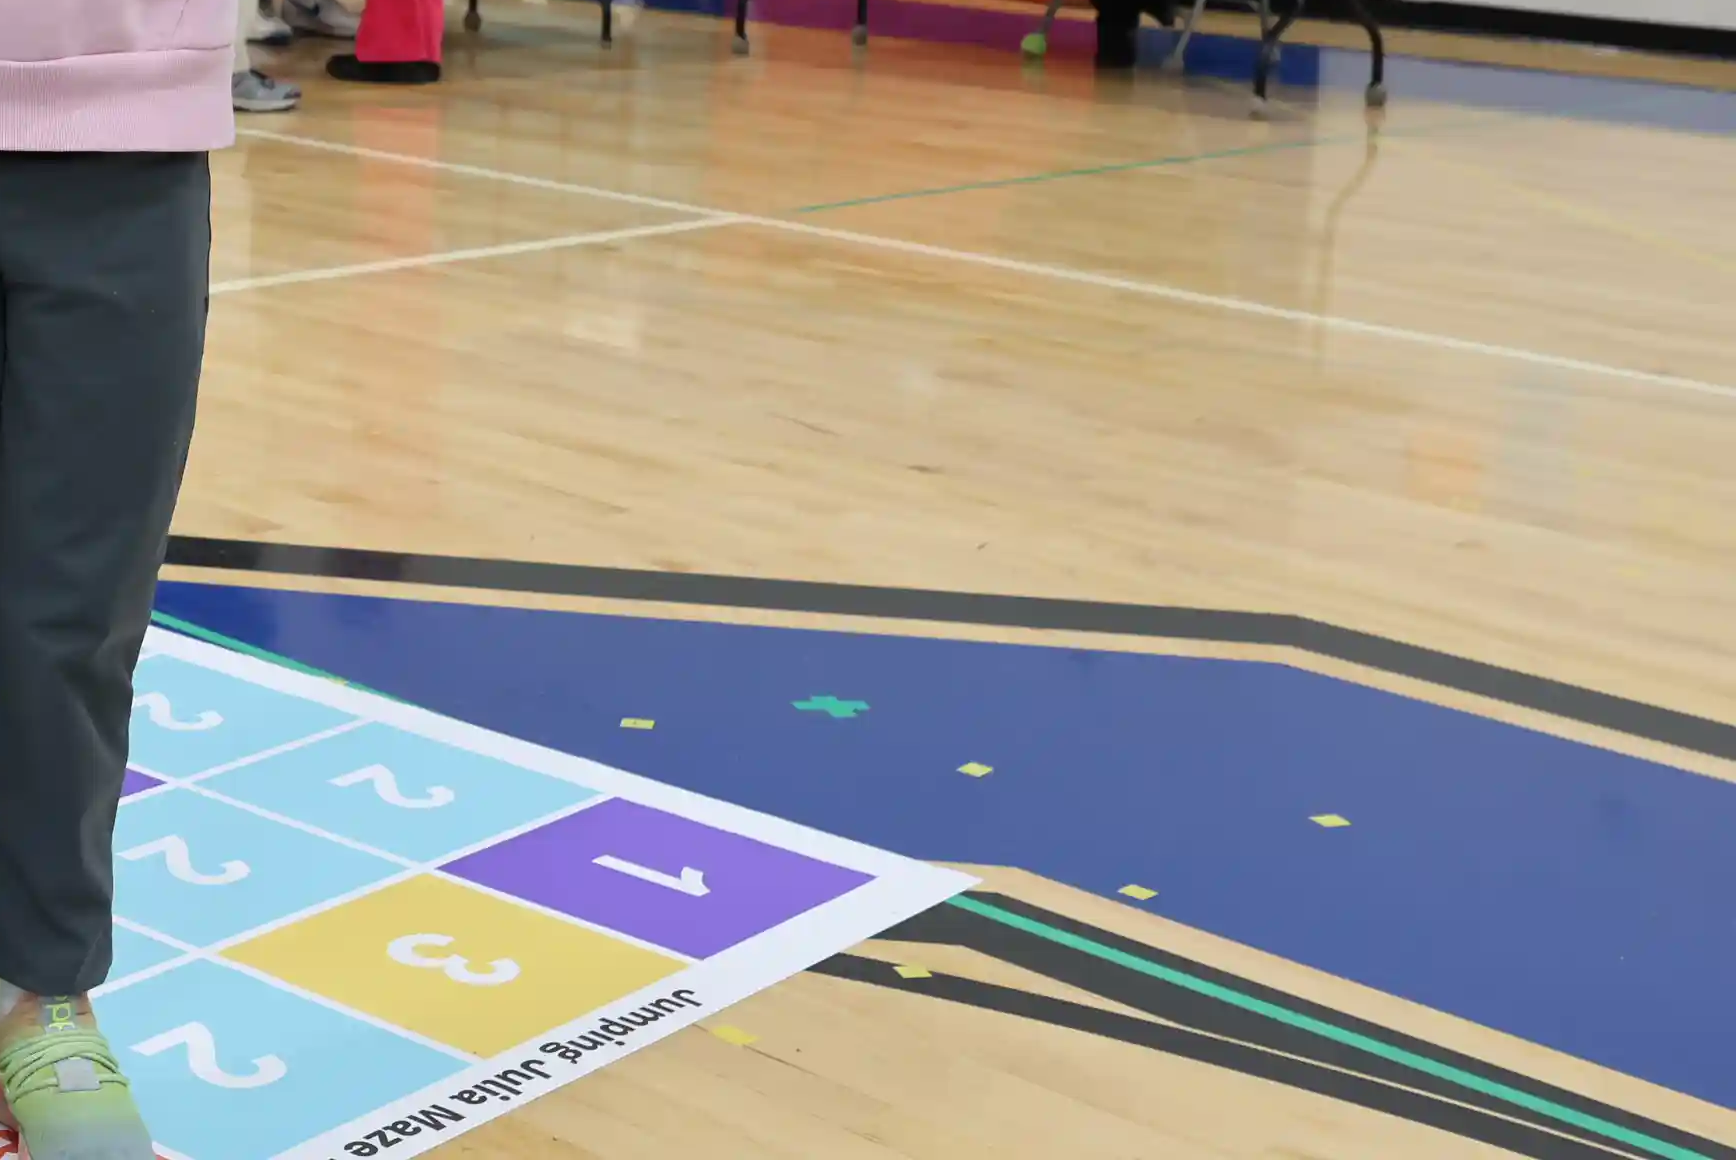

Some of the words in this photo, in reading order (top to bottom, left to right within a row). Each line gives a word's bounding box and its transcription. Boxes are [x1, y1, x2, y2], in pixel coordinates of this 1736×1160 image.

[326, 763, 455, 809] 2
[117, 834, 251, 886] 2
[591, 854, 711, 898] 1
[386, 932, 522, 987] 3
[539, 988, 702, 1065] Jumping
[131, 1021, 288, 1090] 2
[449, 1059, 552, 1105] Julia
[343, 1104, 466, 1158] Maze
